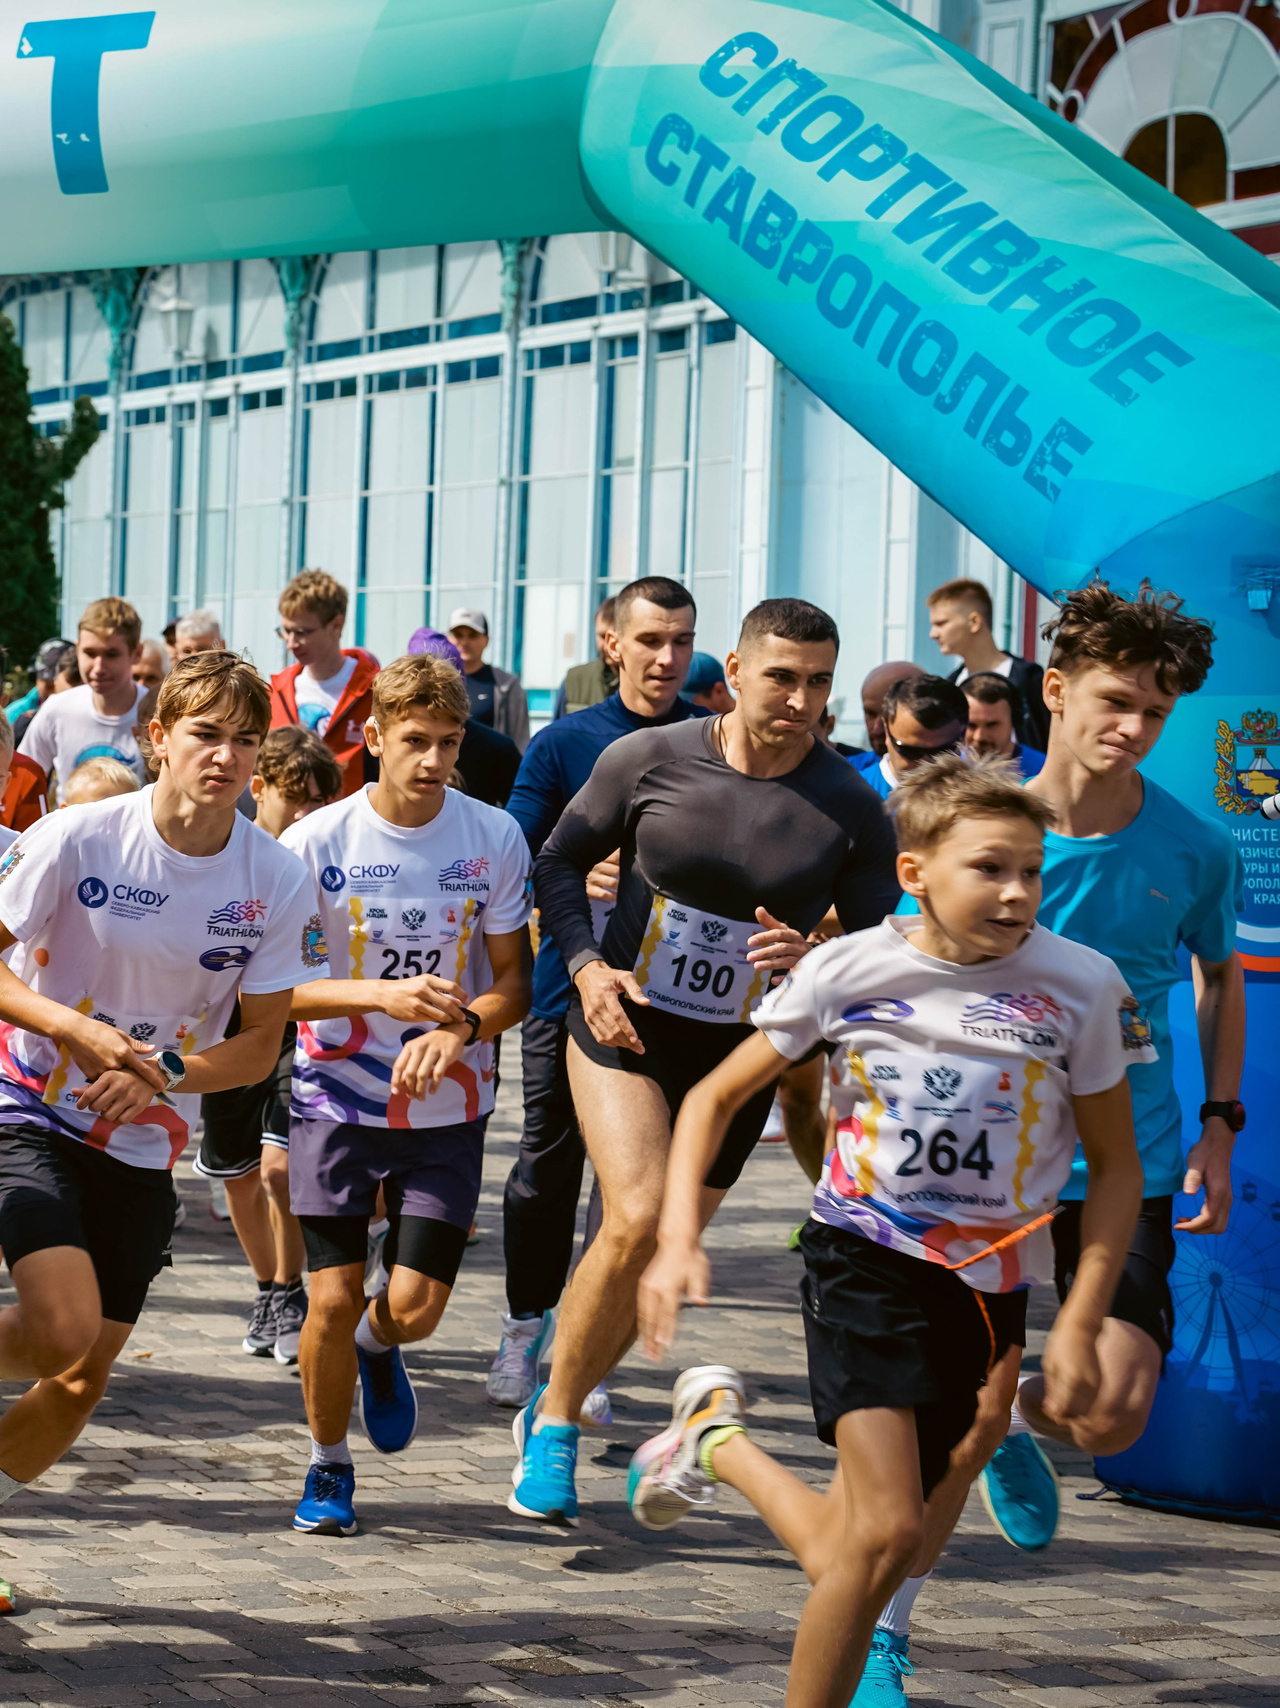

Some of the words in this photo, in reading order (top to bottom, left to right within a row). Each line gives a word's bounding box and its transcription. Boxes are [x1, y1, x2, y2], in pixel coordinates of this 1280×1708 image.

[698, 31, 1194, 407] СПОРТИВНОЕ
[644, 113, 1093, 503] СТАВРОПОЛЬЕ
[349, 864, 400, 878] СКФУ
[113, 884, 170, 907] СКФУ
[439, 883, 490, 891] TRIATHLON
[207, 925, 264, 938] TRIATHLON
[379, 948, 441, 980] 252
[671, 954, 735, 998] 190
[647, 990, 716, 1015] СТАВРОПОЛЬСКИЙ
[716, 1007, 735, 1016] КРАЙ
[960, 1025, 1058, 1049] TRIATHLON
[895, 1128, 995, 1181] 264
